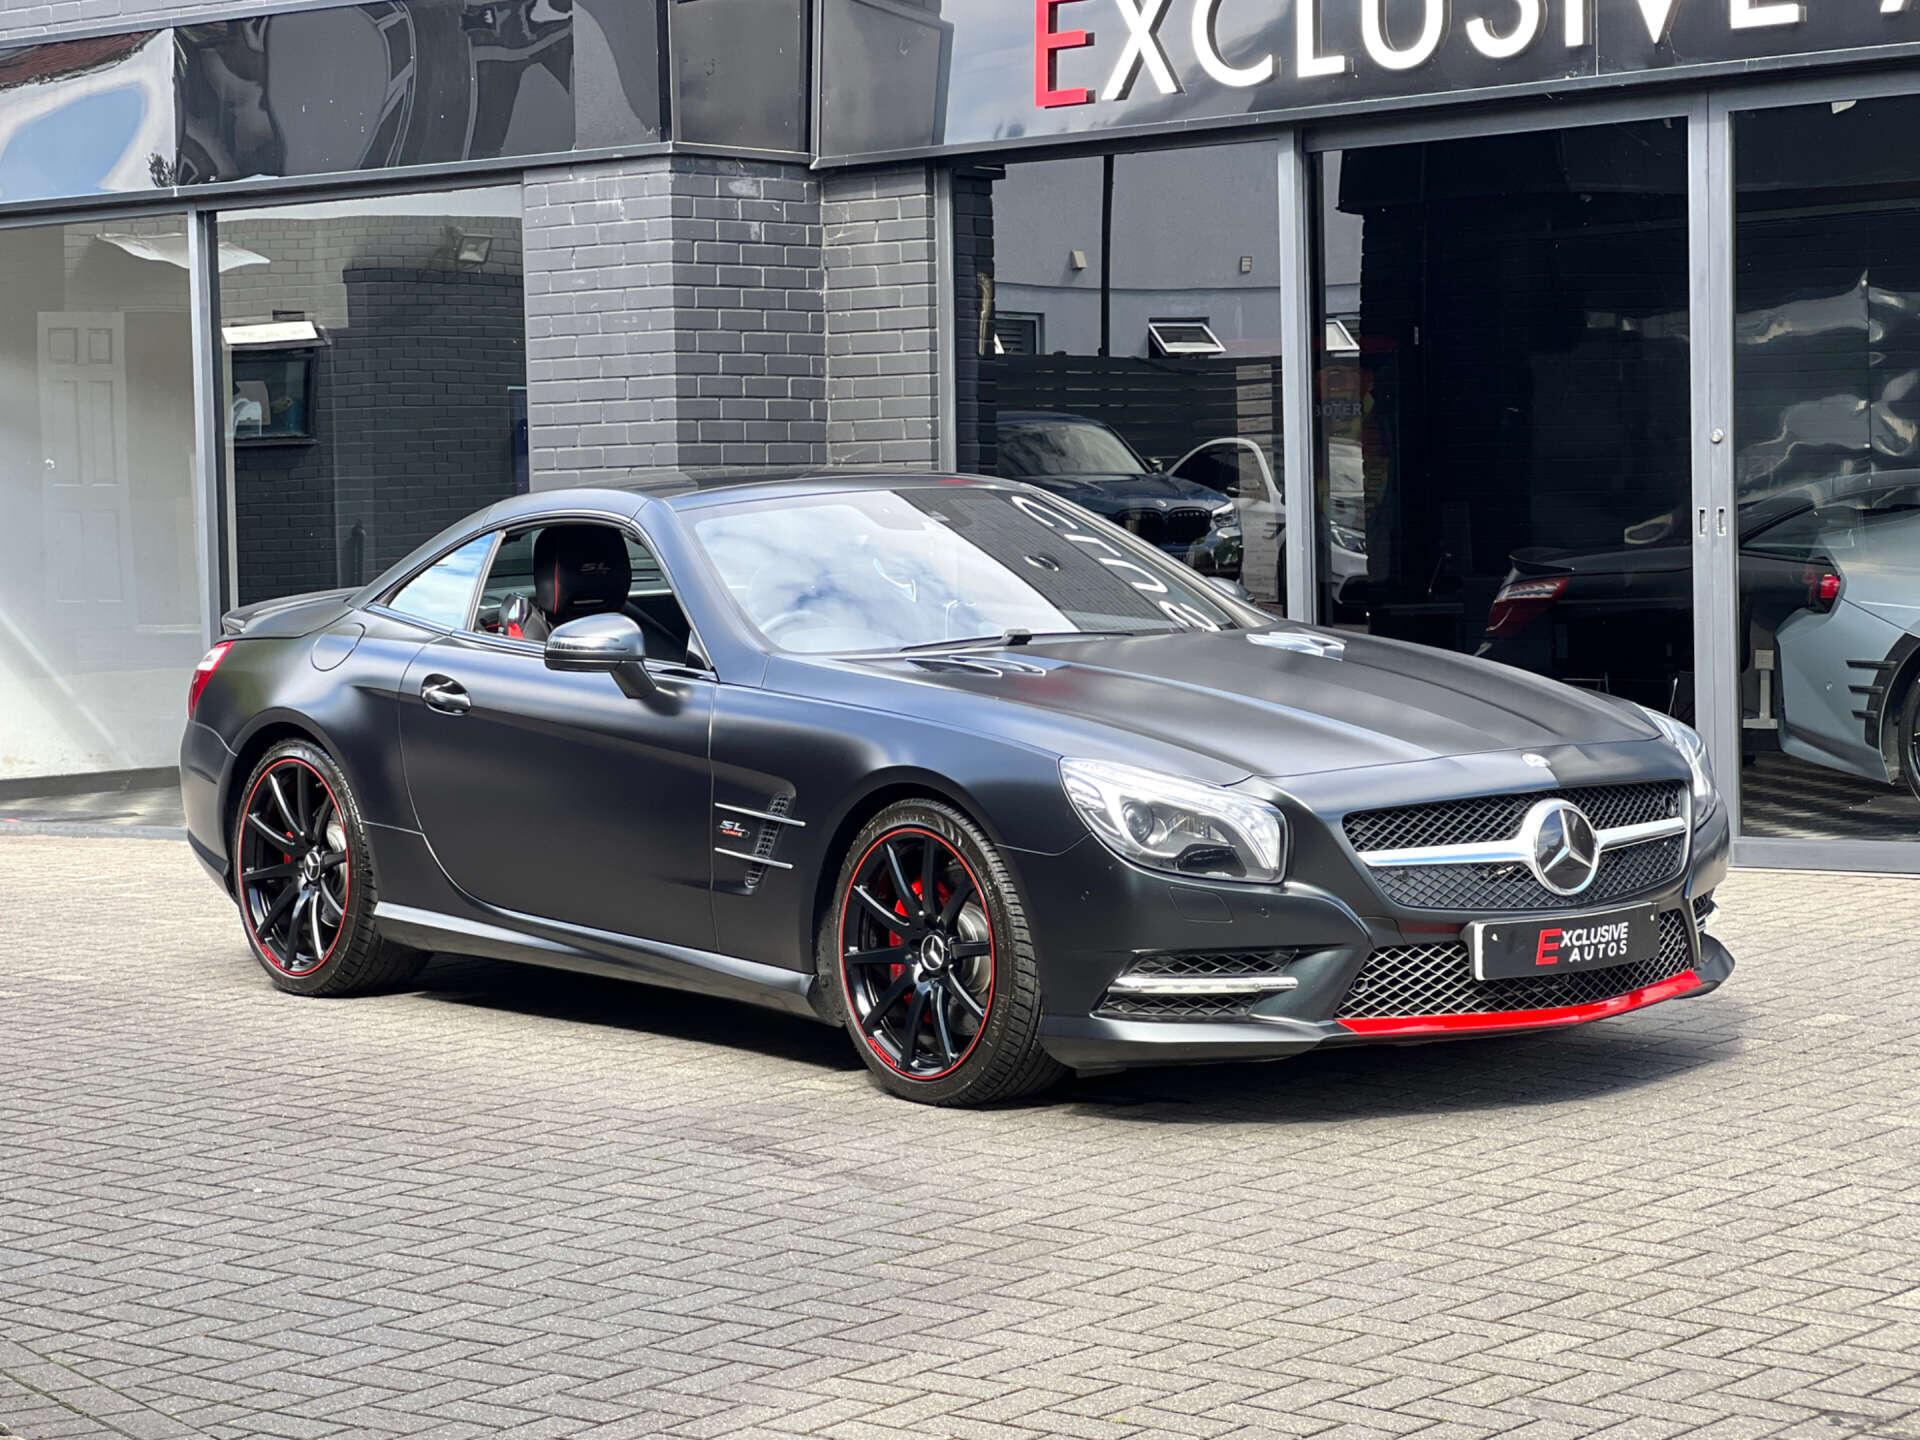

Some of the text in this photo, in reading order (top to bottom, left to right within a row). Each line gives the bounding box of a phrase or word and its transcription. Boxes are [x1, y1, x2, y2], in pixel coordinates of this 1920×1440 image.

[1034, 0, 1804, 108] EXCLU
[719, 820, 747, 832] SL
[1536, 921, 1629, 966] EXCLUSIVE
[1568, 940, 1628, 963] AUTOS
